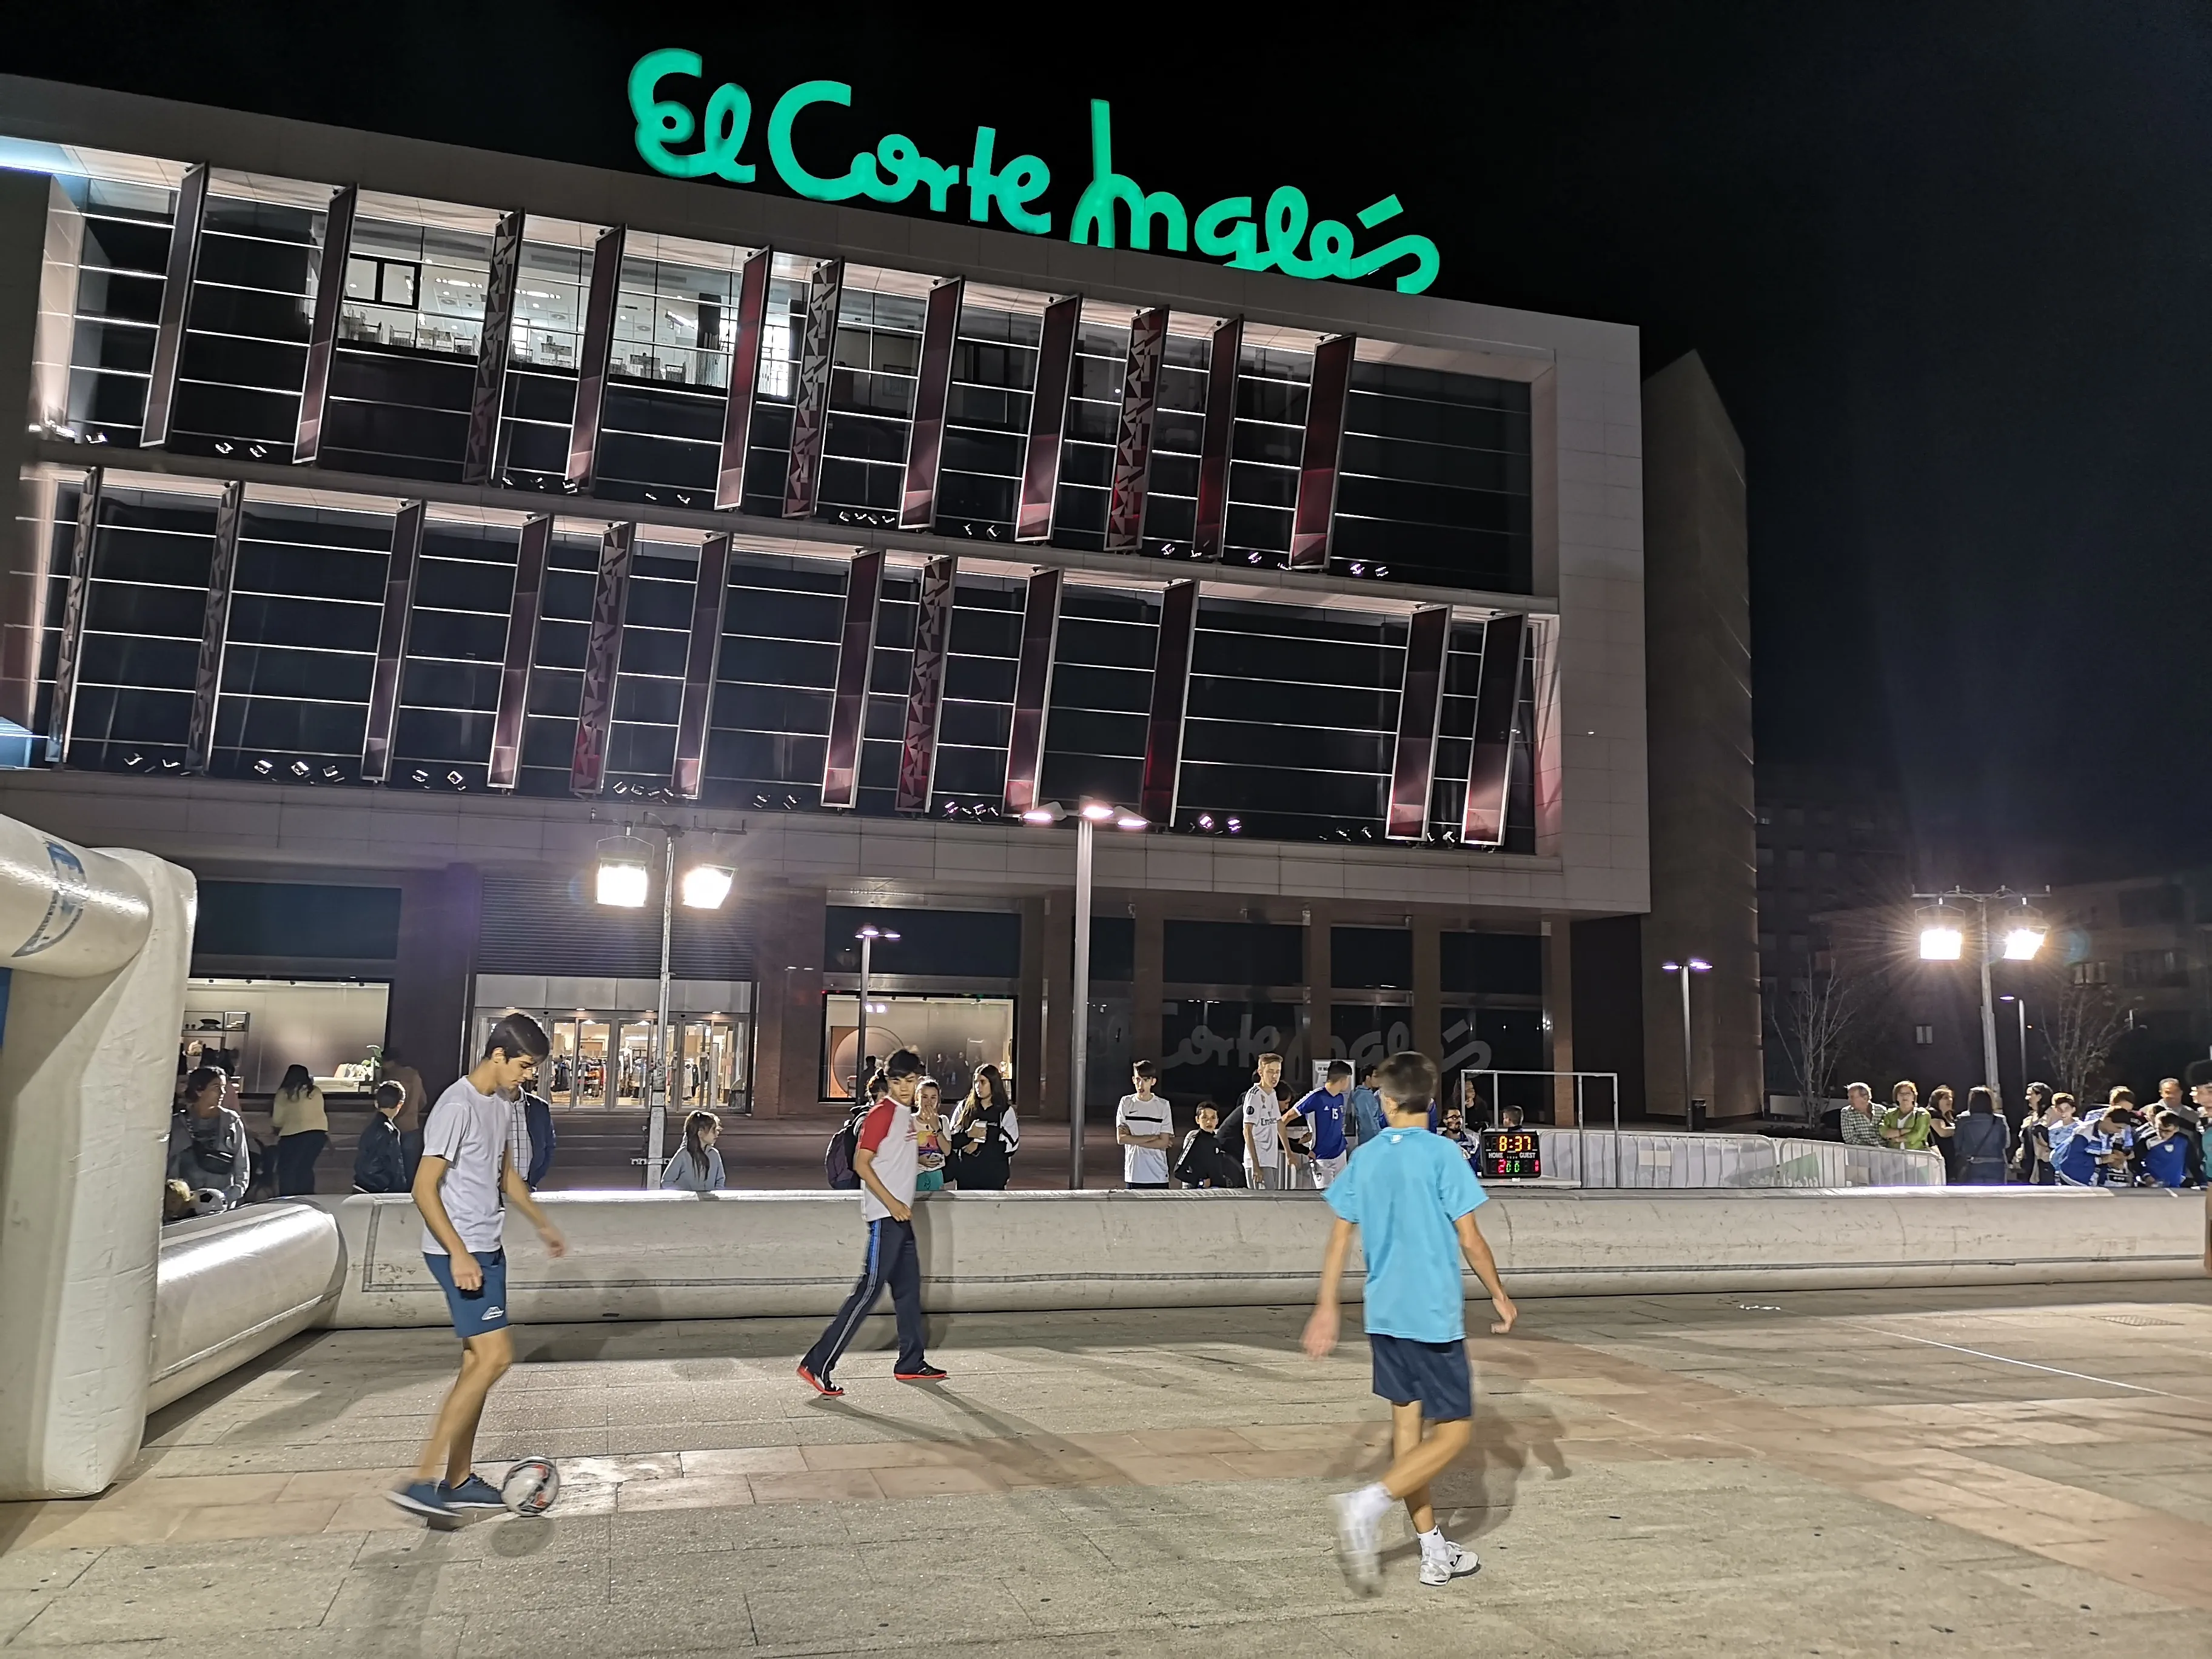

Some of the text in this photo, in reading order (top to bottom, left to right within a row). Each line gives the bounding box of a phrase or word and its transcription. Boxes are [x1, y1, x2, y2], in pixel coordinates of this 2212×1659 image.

[628, 48, 1440, 295] El Corte Inglés
[1332, 1108, 1338, 1120] 15
[1499, 1135, 1531, 1151] 8:37
[1498, 1159, 1506, 1173] 2
